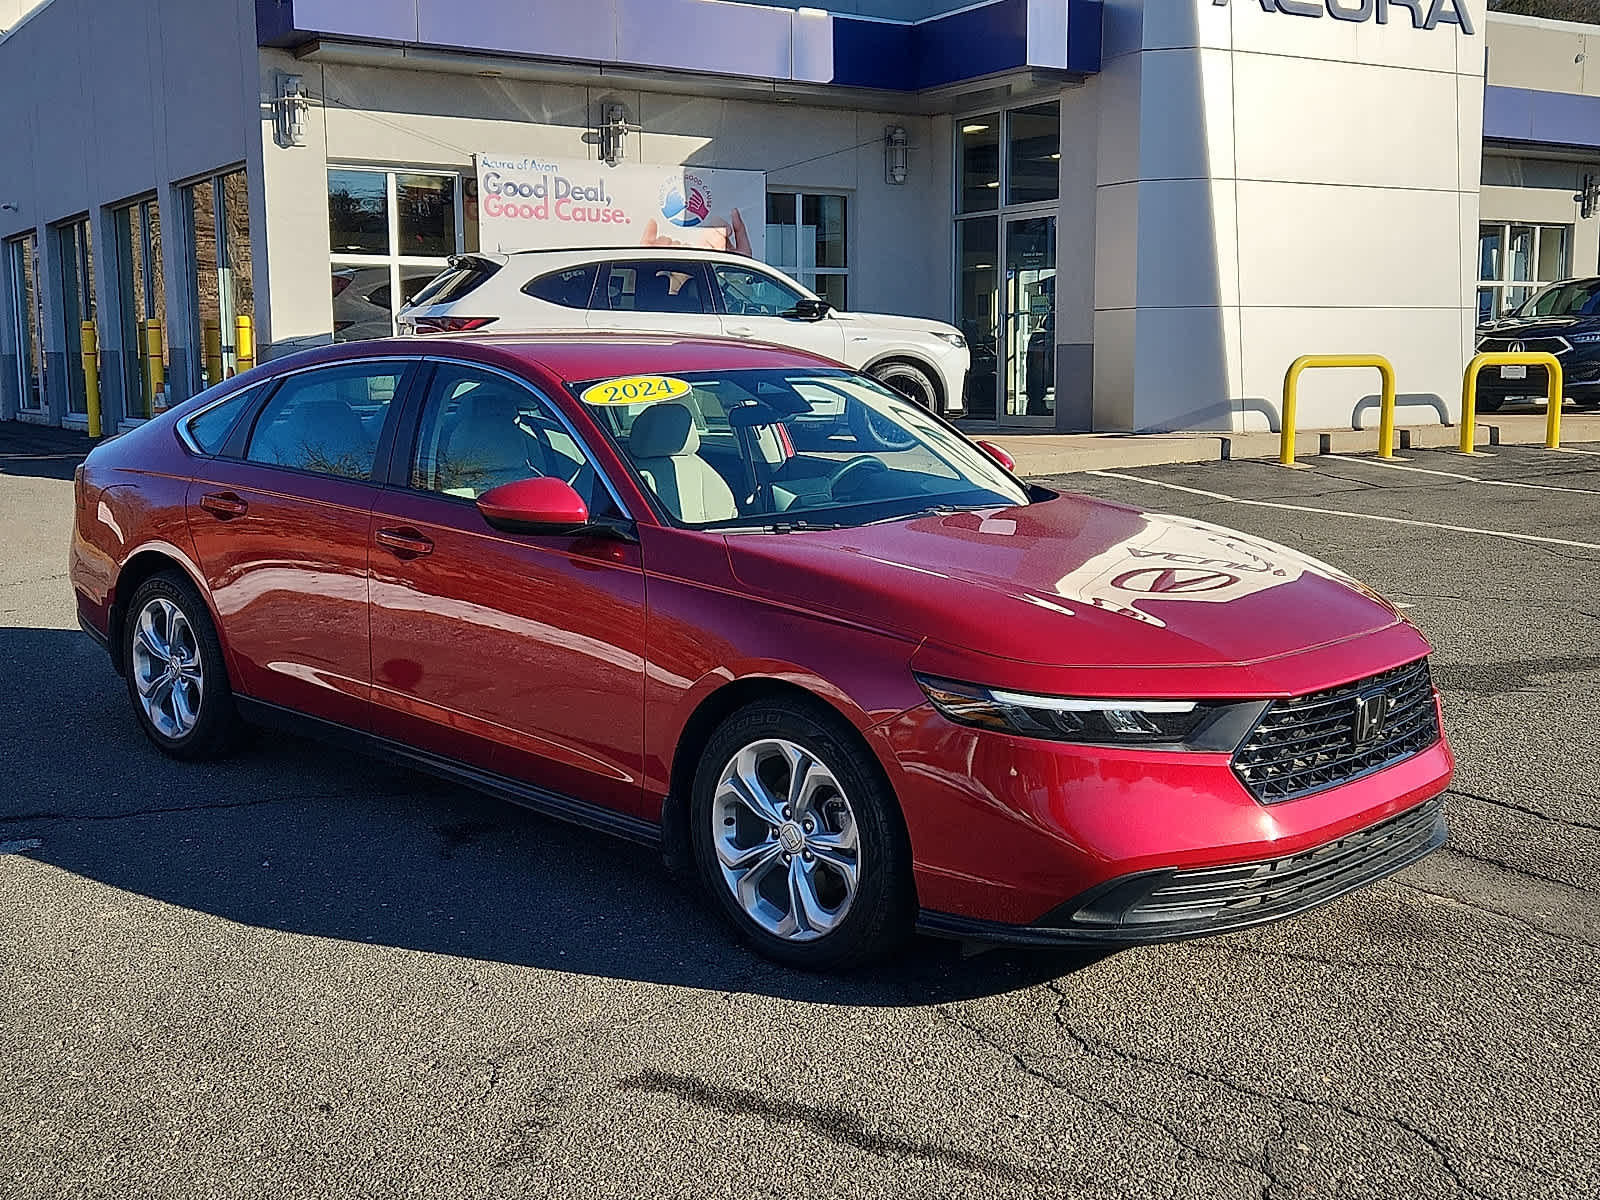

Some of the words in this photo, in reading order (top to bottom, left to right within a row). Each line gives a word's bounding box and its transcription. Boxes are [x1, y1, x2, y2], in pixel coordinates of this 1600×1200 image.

[481, 156, 514, 170] Acura
[517, 159, 528, 170] of
[530, 159, 559, 172] Avon
[483, 171, 548, 198] Good
[554, 176, 613, 206] Deal,
[483, 193, 549, 220] Good
[554, 197, 631, 224] Cause.
[604, 379, 674, 402] 2024
